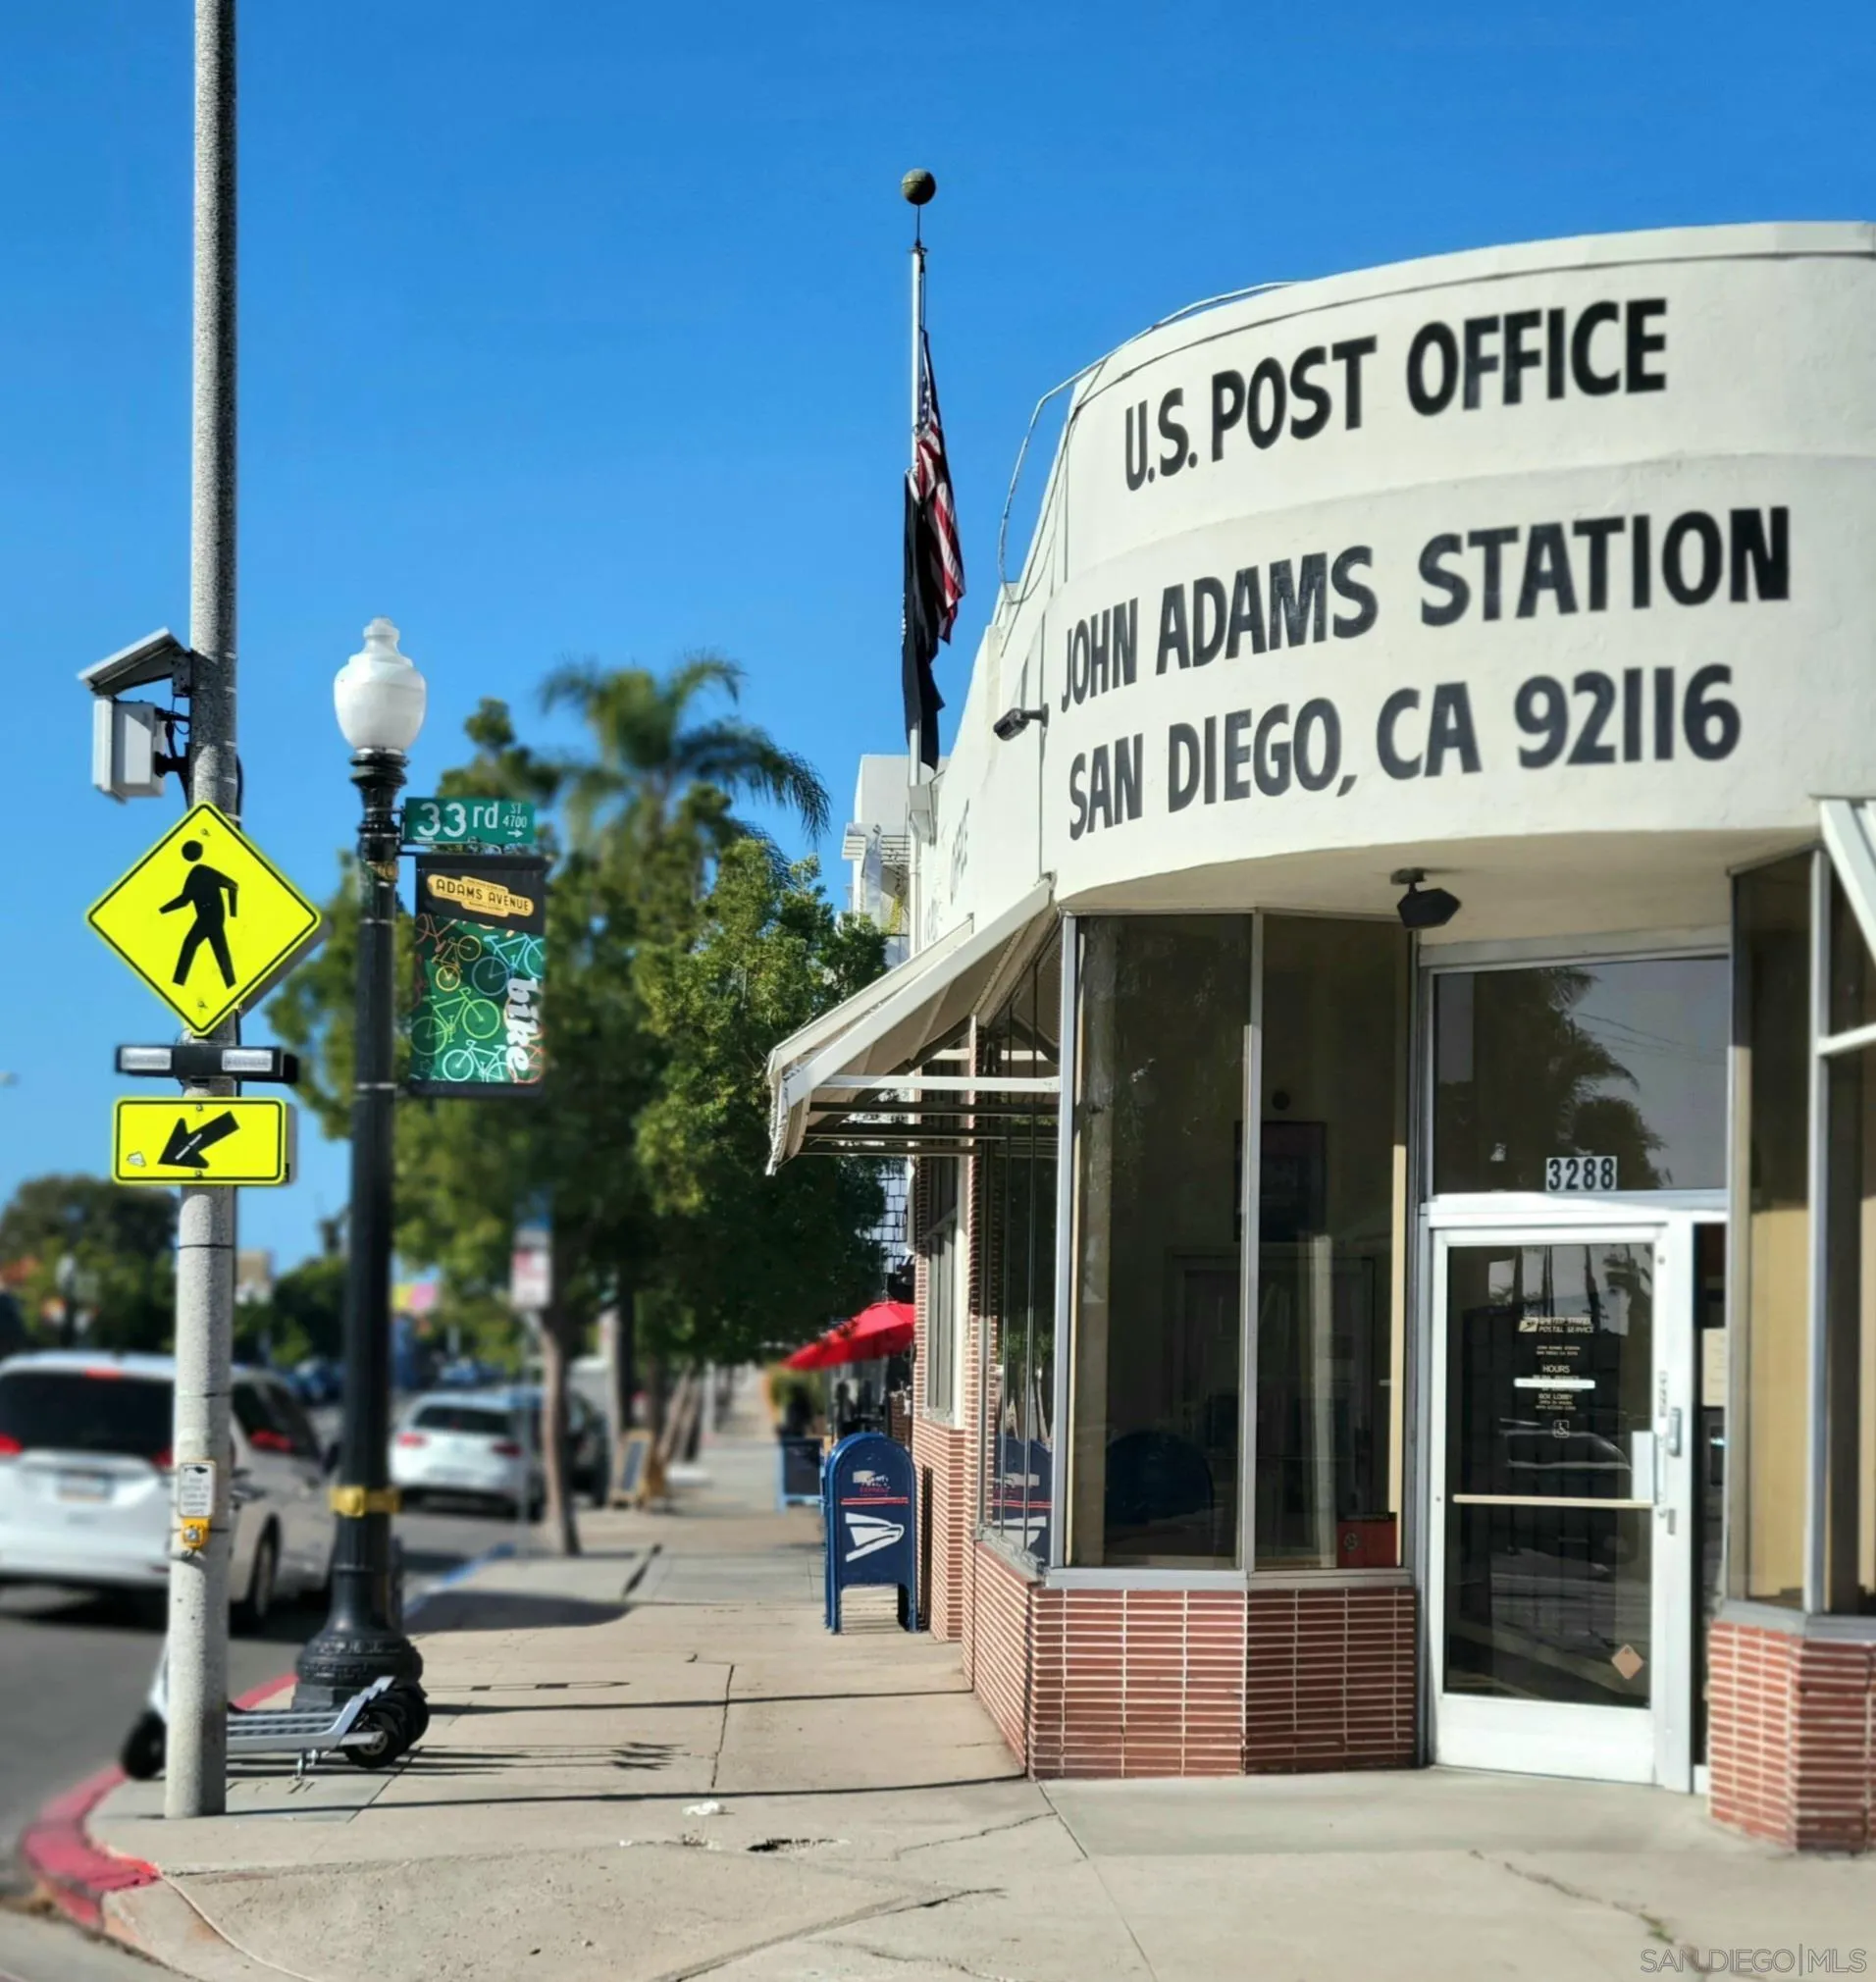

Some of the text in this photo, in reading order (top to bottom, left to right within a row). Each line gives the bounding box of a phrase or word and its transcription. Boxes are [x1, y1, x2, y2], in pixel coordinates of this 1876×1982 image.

[1125, 298, 1667, 491] U.S. POST OFFICE
[1062, 505, 1790, 712] JOHN ADAMS STATION
[1069, 664, 1741, 840] SAN DIEGO, CA 92116
[417, 802, 499, 837] 33rd
[502, 815, 528, 828] 4700
[436, 878, 484, 901] ADAMS
[489, 891, 530, 912] AVENUE
[505, 977, 539, 1083] bike
[1548, 1157, 1615, 1191] 3288
[1542, 1364, 1571, 1374] HOURS
